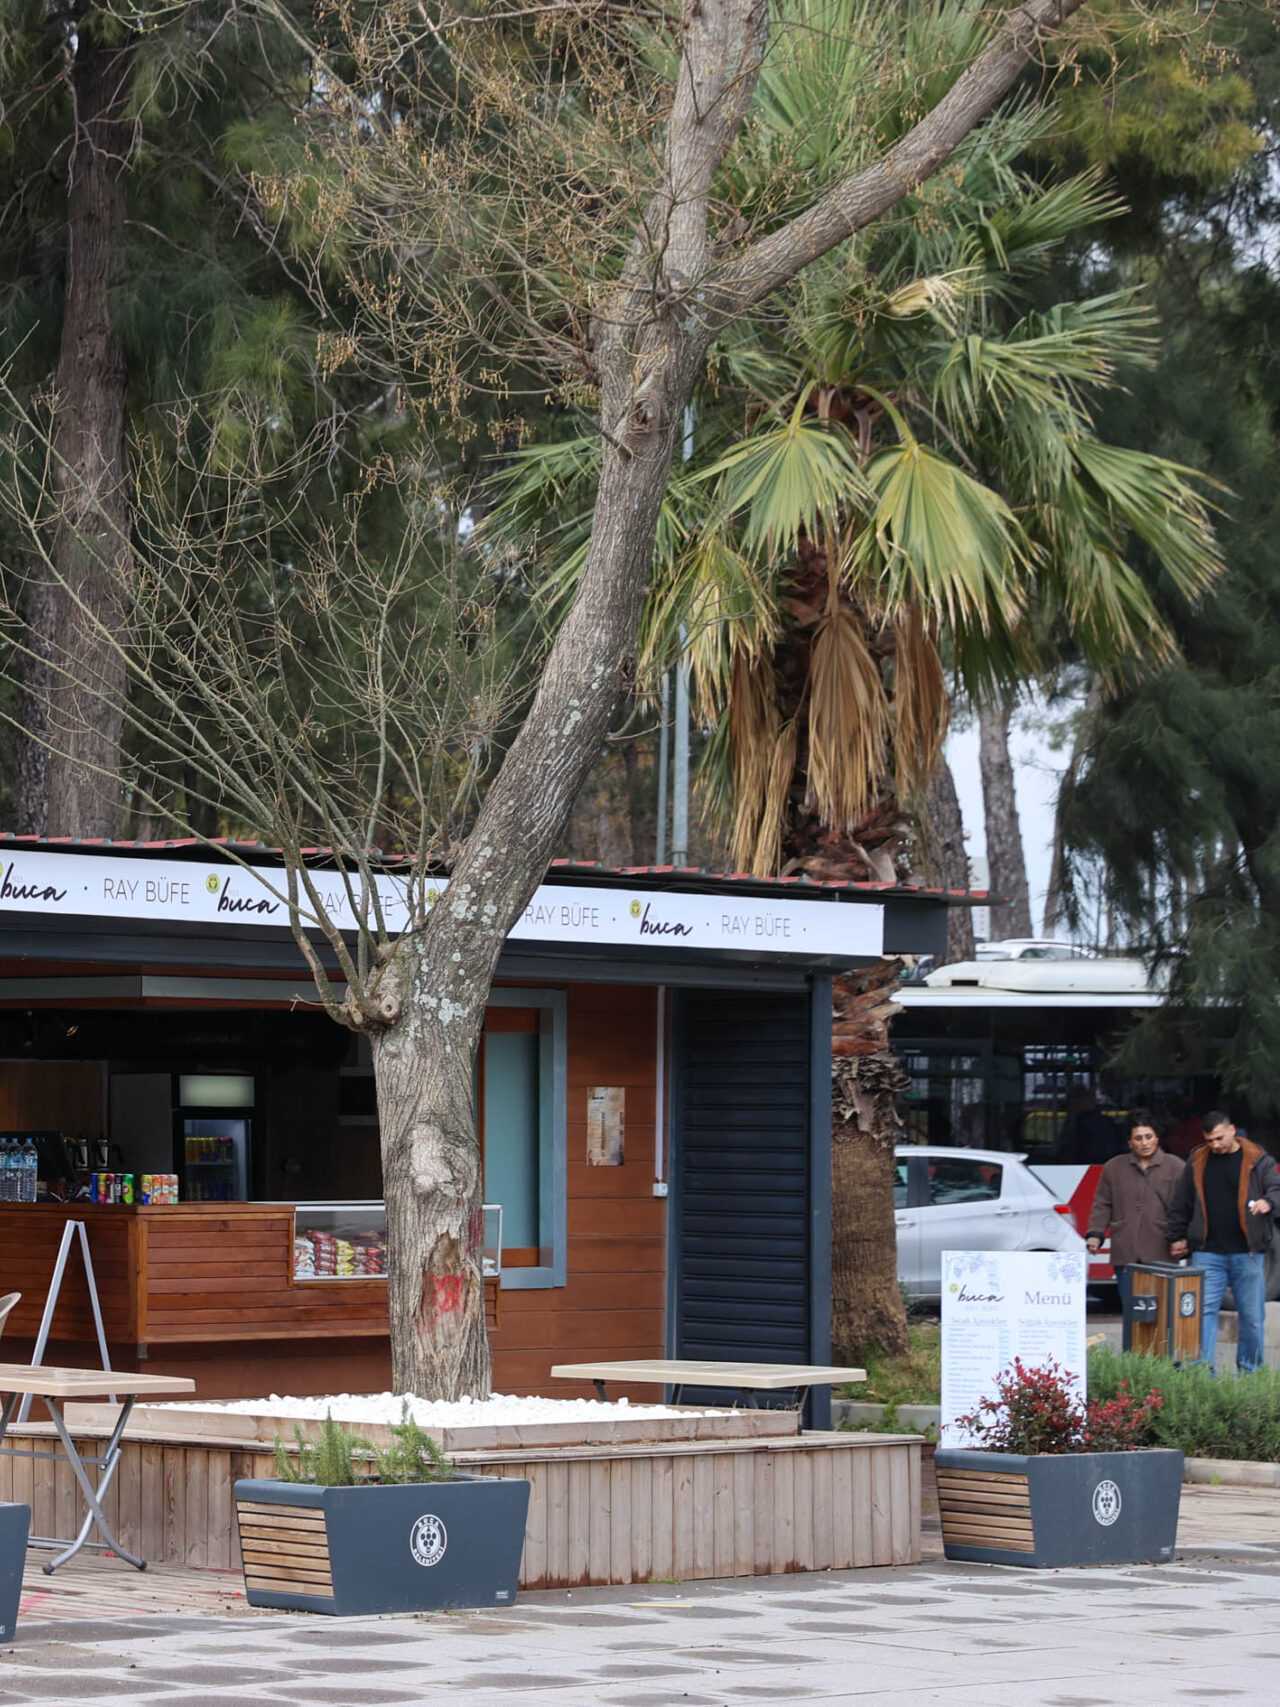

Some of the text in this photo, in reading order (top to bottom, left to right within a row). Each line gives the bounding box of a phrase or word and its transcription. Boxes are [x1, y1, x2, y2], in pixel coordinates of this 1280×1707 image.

[0, 861, 67, 901] buca
[103, 877, 139, 901] RAY
[145, 876, 190, 905] BÜFE
[217, 876, 280, 914] buca
[524, 904, 556, 925] RAY
[561, 902, 599, 928] BÜFE
[640, 902, 693, 936] buca
[721, 914, 750, 935] RAY
[755, 912, 792, 938] BÜFE
[957, 1284, 1005, 1302] buca
[1024, 1291, 1072, 1305] Menü
